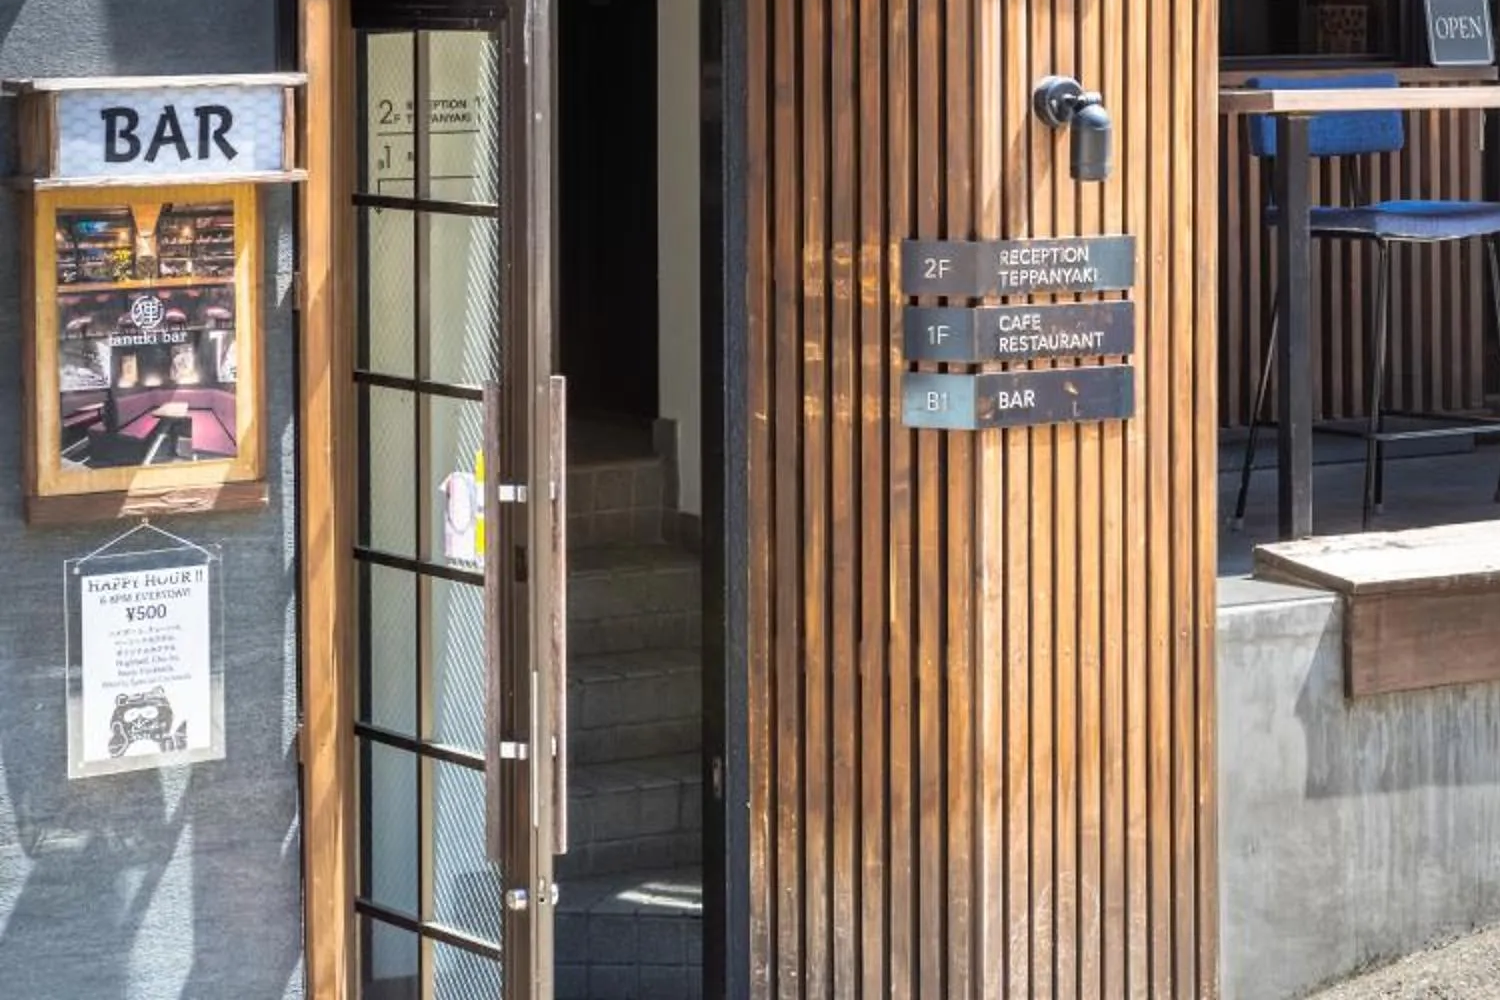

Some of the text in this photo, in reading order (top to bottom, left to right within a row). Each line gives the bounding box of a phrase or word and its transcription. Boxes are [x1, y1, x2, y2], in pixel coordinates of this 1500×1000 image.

[1435, 15, 1483, 39] OPEN
[101, 104, 239, 162] BAR
[924, 245, 1089, 279] 2F RECEPTION
[998, 267, 1099, 288] TEPPANYAKI
[927, 313, 1041, 345] 1F CAFE
[1000, 331, 1105, 353] RESTAURANT
[927, 389, 1036, 411] B1 BAR
[144, 571, 192, 587] HOUR
[126, 603, 168, 623] ¥500
